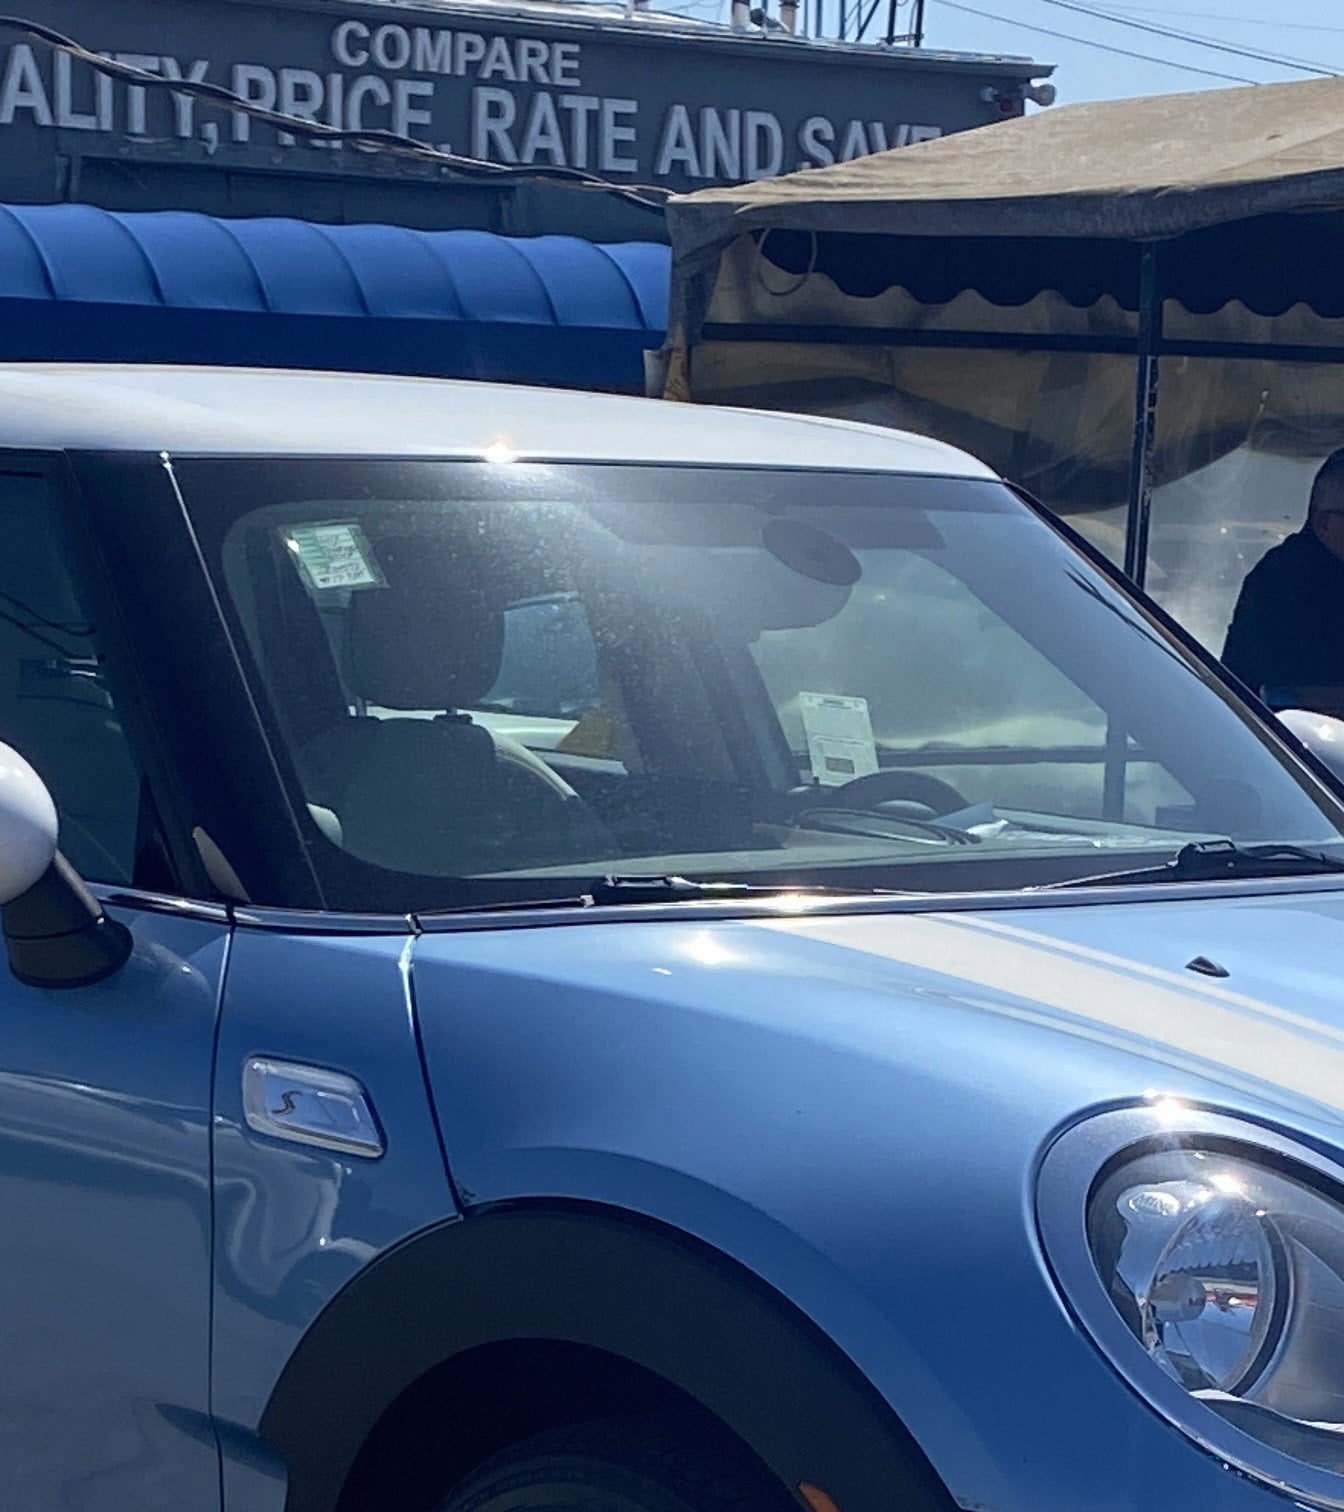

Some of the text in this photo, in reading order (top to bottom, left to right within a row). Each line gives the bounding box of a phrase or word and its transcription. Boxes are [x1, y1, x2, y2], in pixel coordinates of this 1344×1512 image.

[332, 20, 582, 87] COMPARE
[471, 86, 639, 173] RATE
[658, 104, 784, 182] AND
